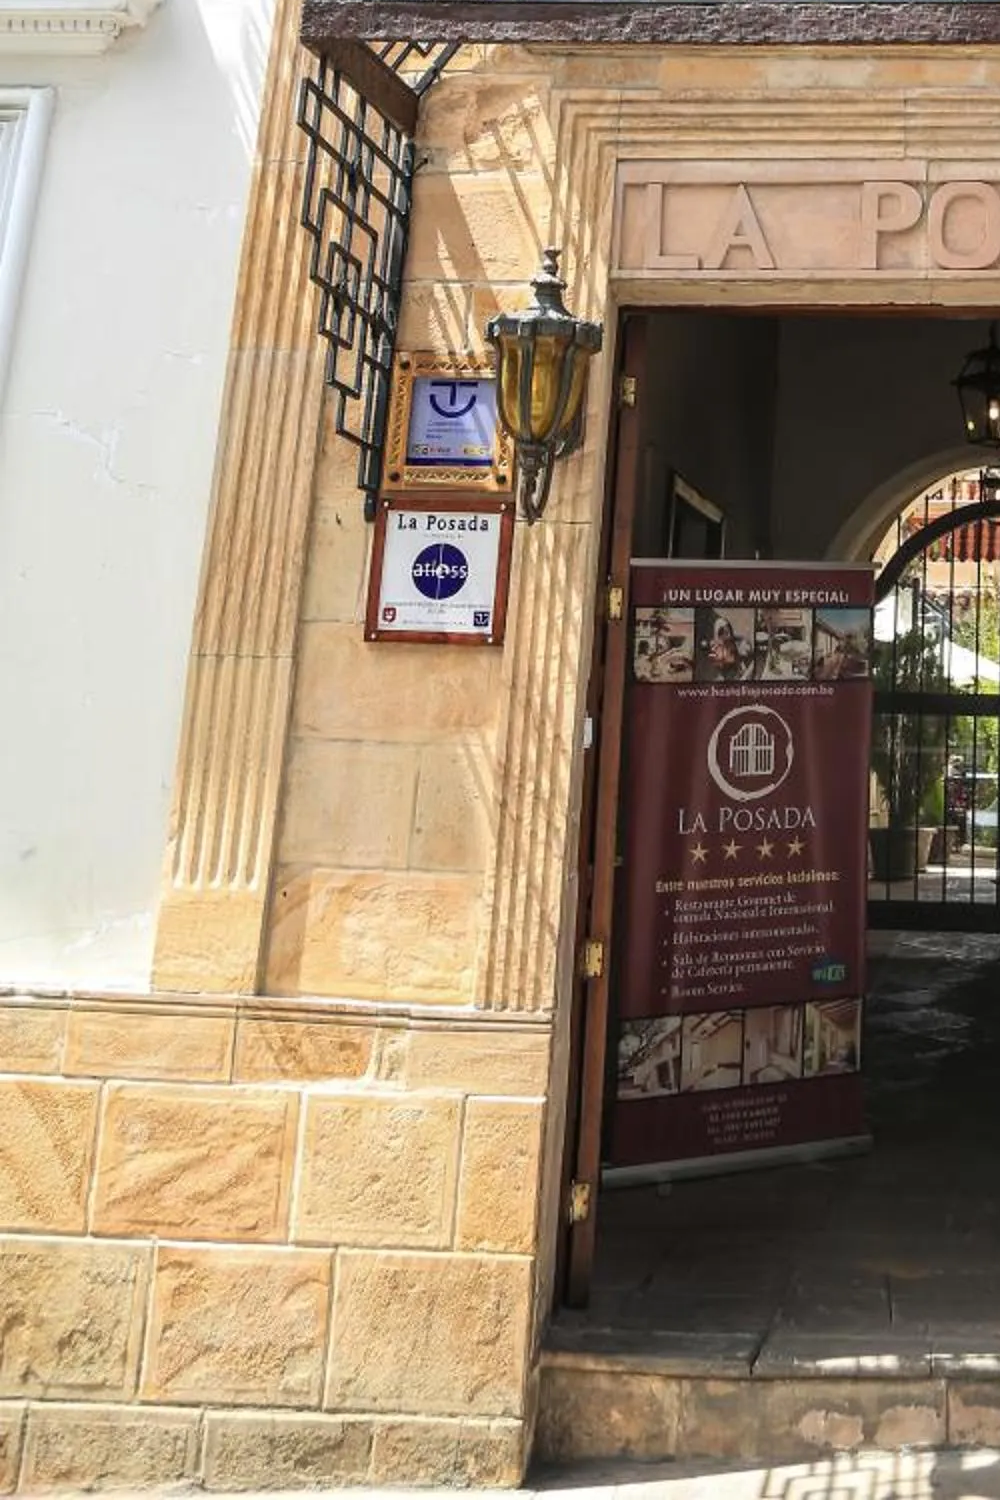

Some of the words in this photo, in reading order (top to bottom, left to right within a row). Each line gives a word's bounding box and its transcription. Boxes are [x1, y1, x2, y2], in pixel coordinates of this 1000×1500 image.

[647, 182, 774, 270] LA
[398, 514, 417, 530] La
[426, 515, 489, 531] Posada
[696, 589, 743, 602] LUGAR
[749, 589, 781, 602] MUY
[679, 808, 708, 835] LA
[719, 805, 817, 833] POSADA
[655, 880, 683, 893] Entre
[738, 872, 784, 888] servicios
